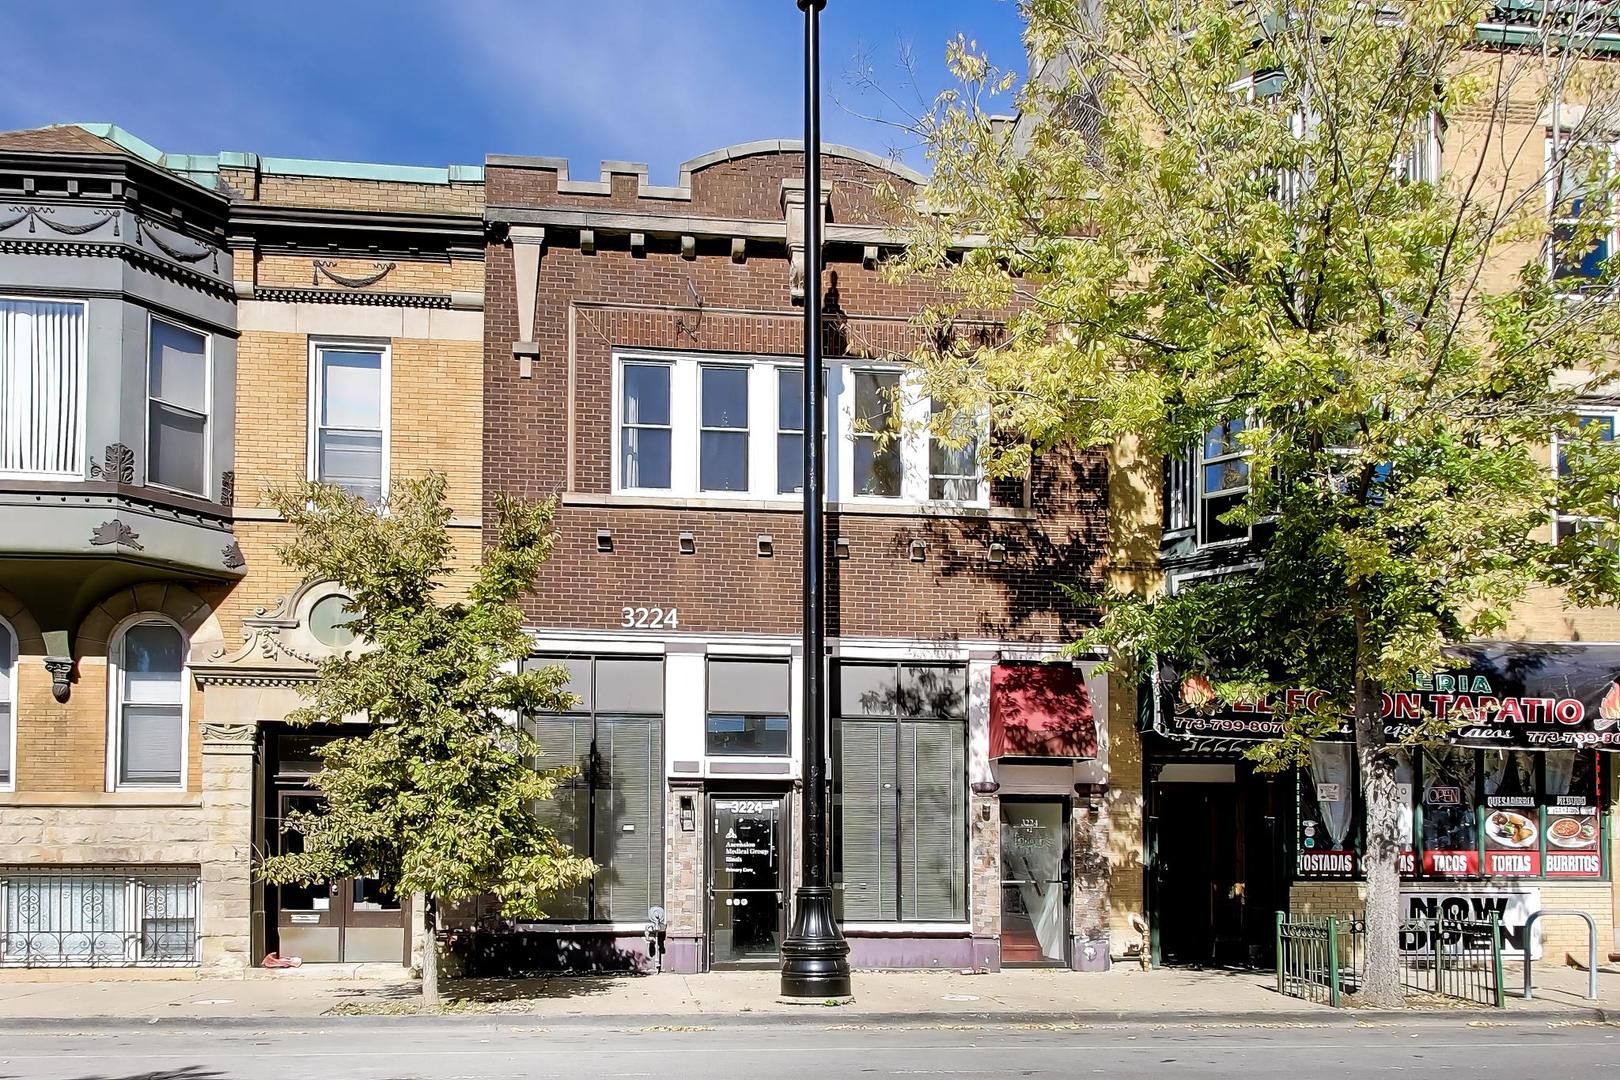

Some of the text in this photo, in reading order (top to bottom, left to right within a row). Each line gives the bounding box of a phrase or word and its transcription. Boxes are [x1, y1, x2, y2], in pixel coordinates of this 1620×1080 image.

[621, 606, 679, 629] 3224
[1429, 694, 1585, 725] TAPATIO
[1428, 788, 1459, 802] OPEN
[730, 801, 763, 814] 3224
[750, 848, 769, 856] Group
[1300, 854, 1353, 872] TOSTADAS
[1432, 854, 1467, 872] TACOS
[1491, 855, 1532, 872] TORTAS
[1545, 855, 1600, 872] BURRITOS
[1409, 897, 1509, 922] NOW
[1400, 923, 1527, 950] OPEN
